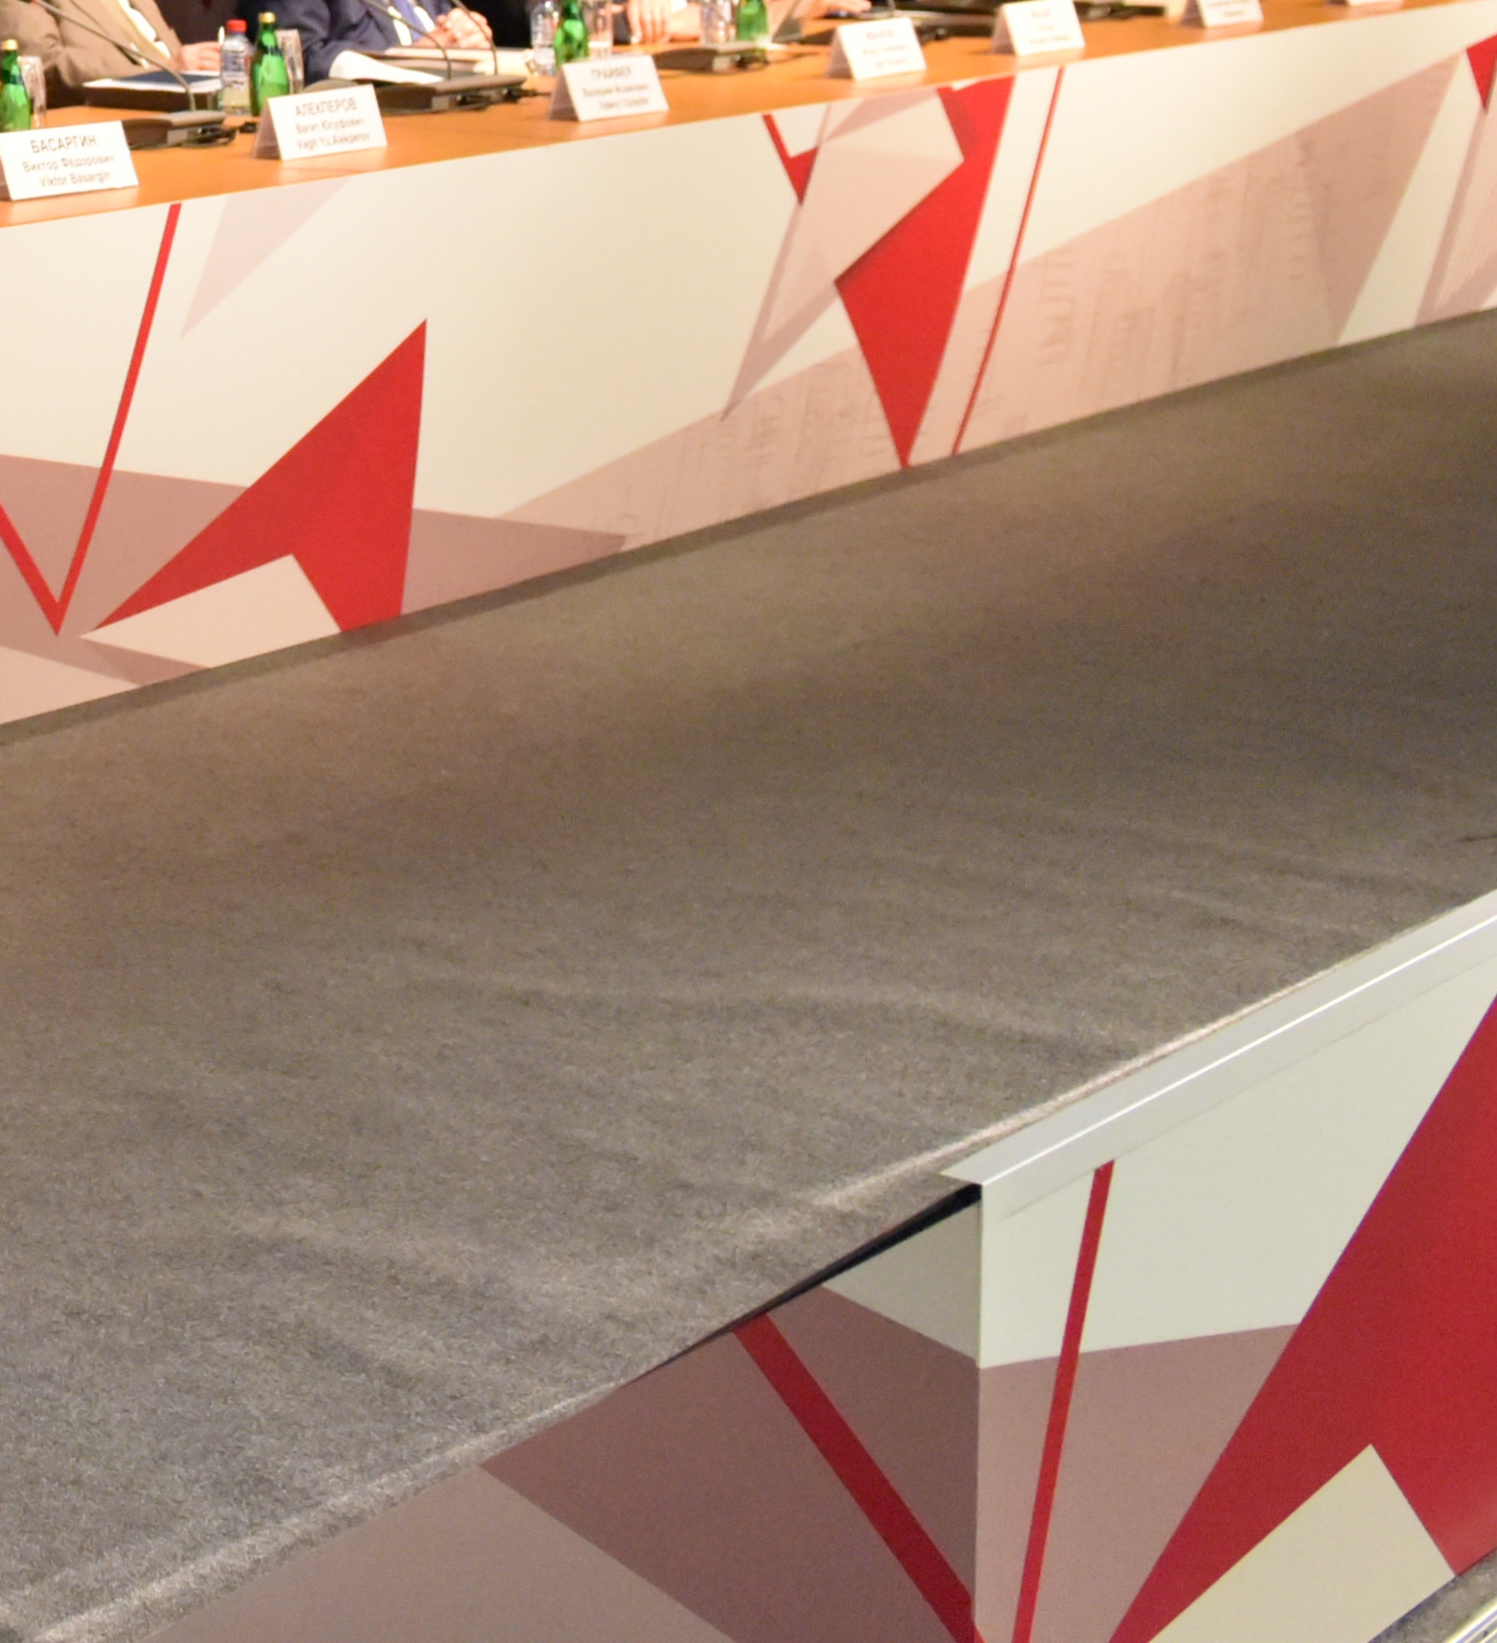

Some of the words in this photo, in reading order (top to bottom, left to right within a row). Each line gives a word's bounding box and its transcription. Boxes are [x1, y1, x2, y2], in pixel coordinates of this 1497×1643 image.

[296, 97, 357, 116] АЛЕКПЕРОВ
[30, 134, 98, 154] БАСАРГИН
[22, 160, 59, 173] Виктор
[70, 171, 111, 184] Basargin
